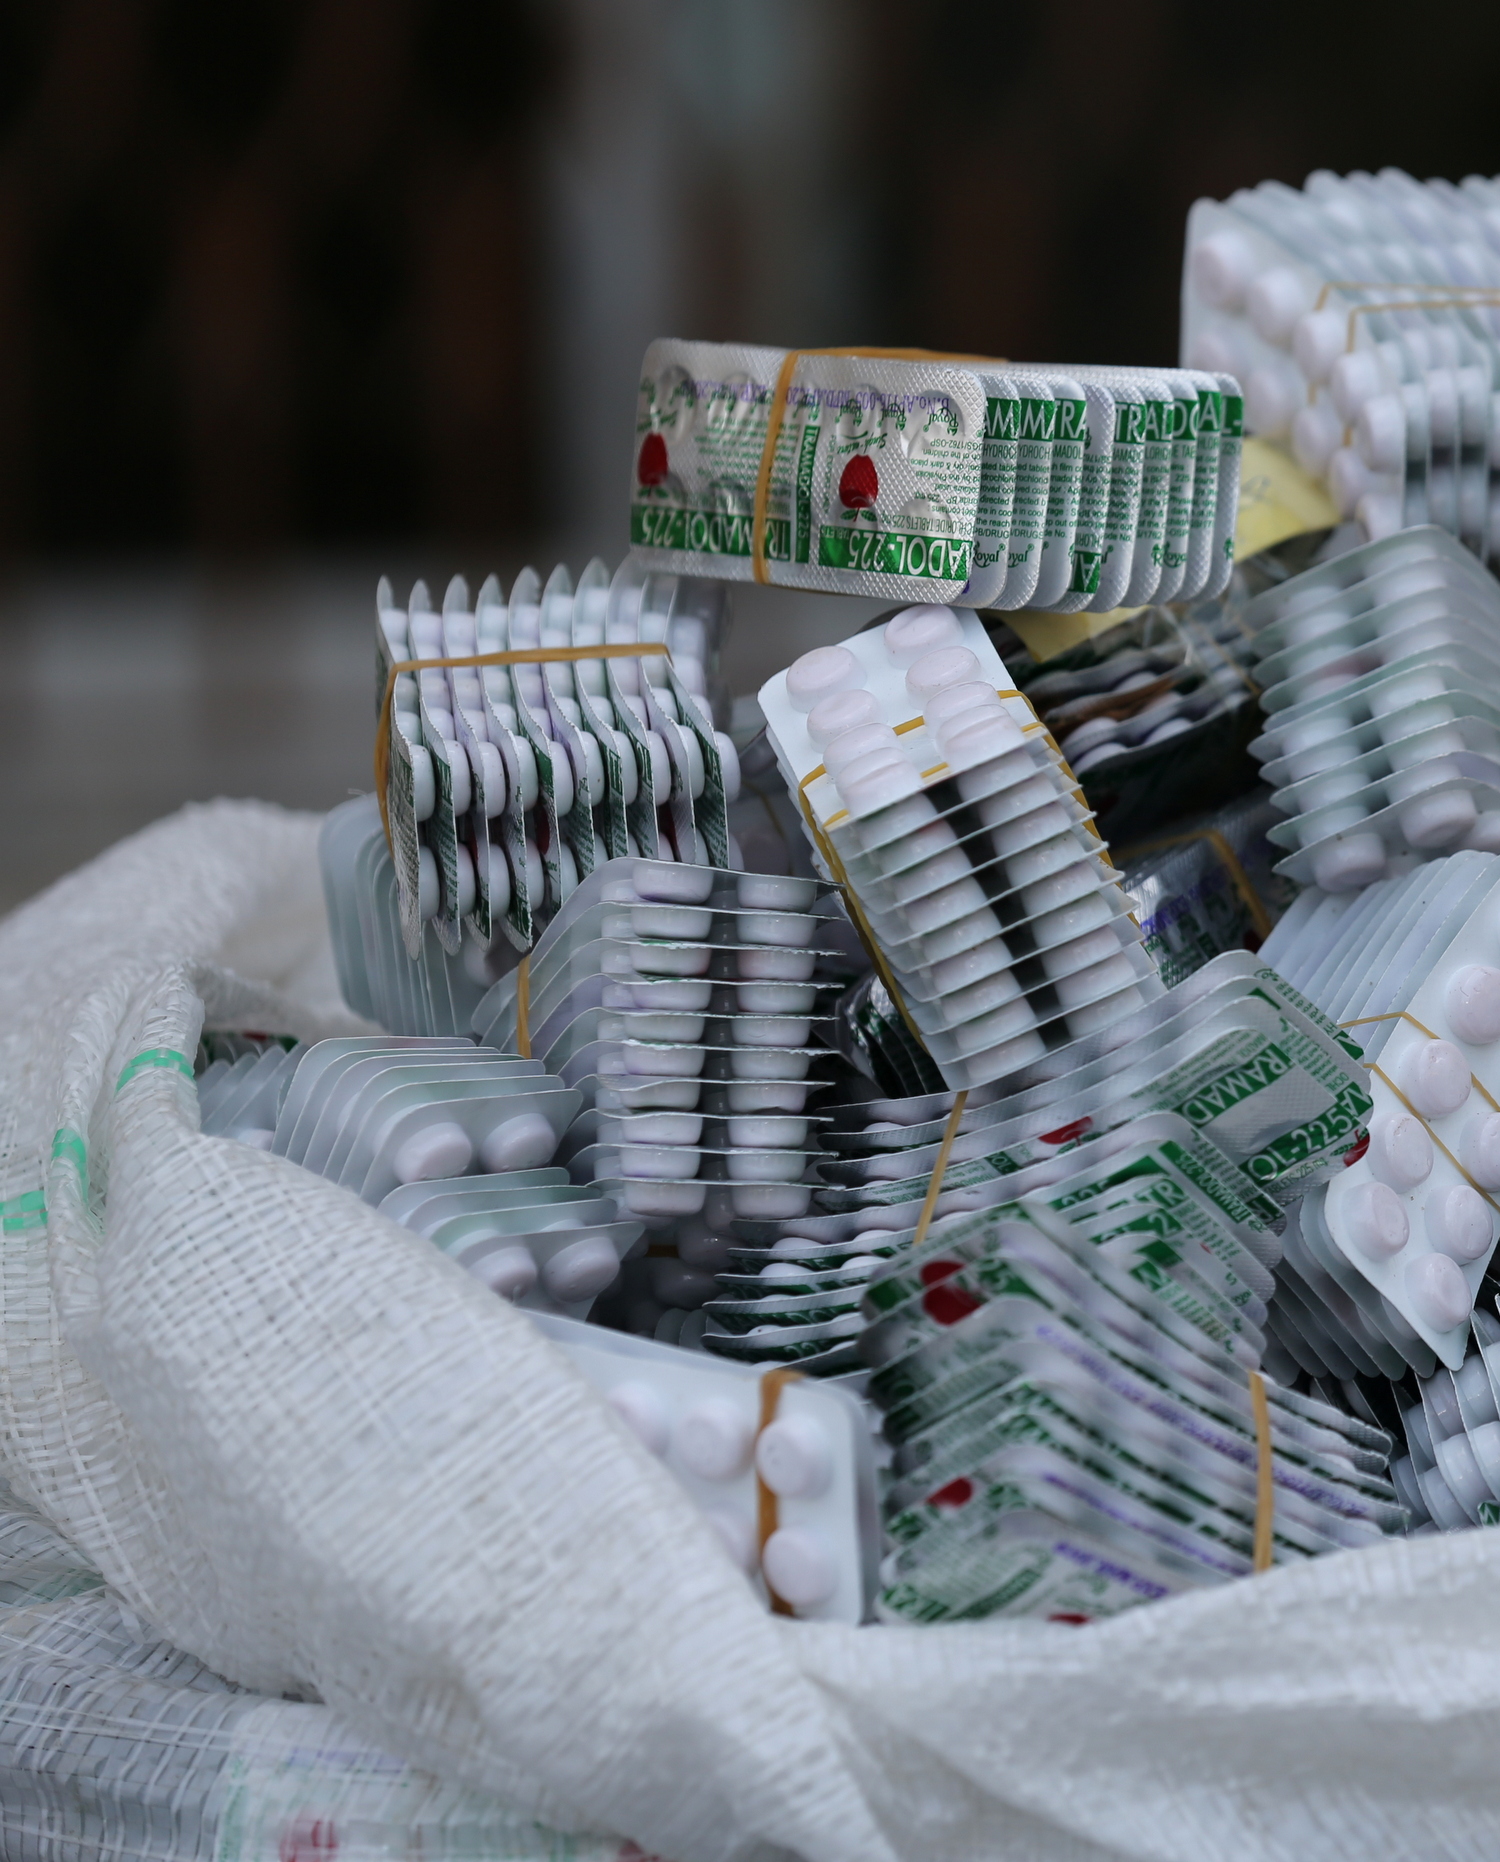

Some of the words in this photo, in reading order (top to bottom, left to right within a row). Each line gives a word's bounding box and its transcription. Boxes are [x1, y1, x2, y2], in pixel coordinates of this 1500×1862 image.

[930, 459, 944, 468] dark
[905, 515, 933, 530] TABLETS
[1183, 1049, 1297, 1123] RAMAD
